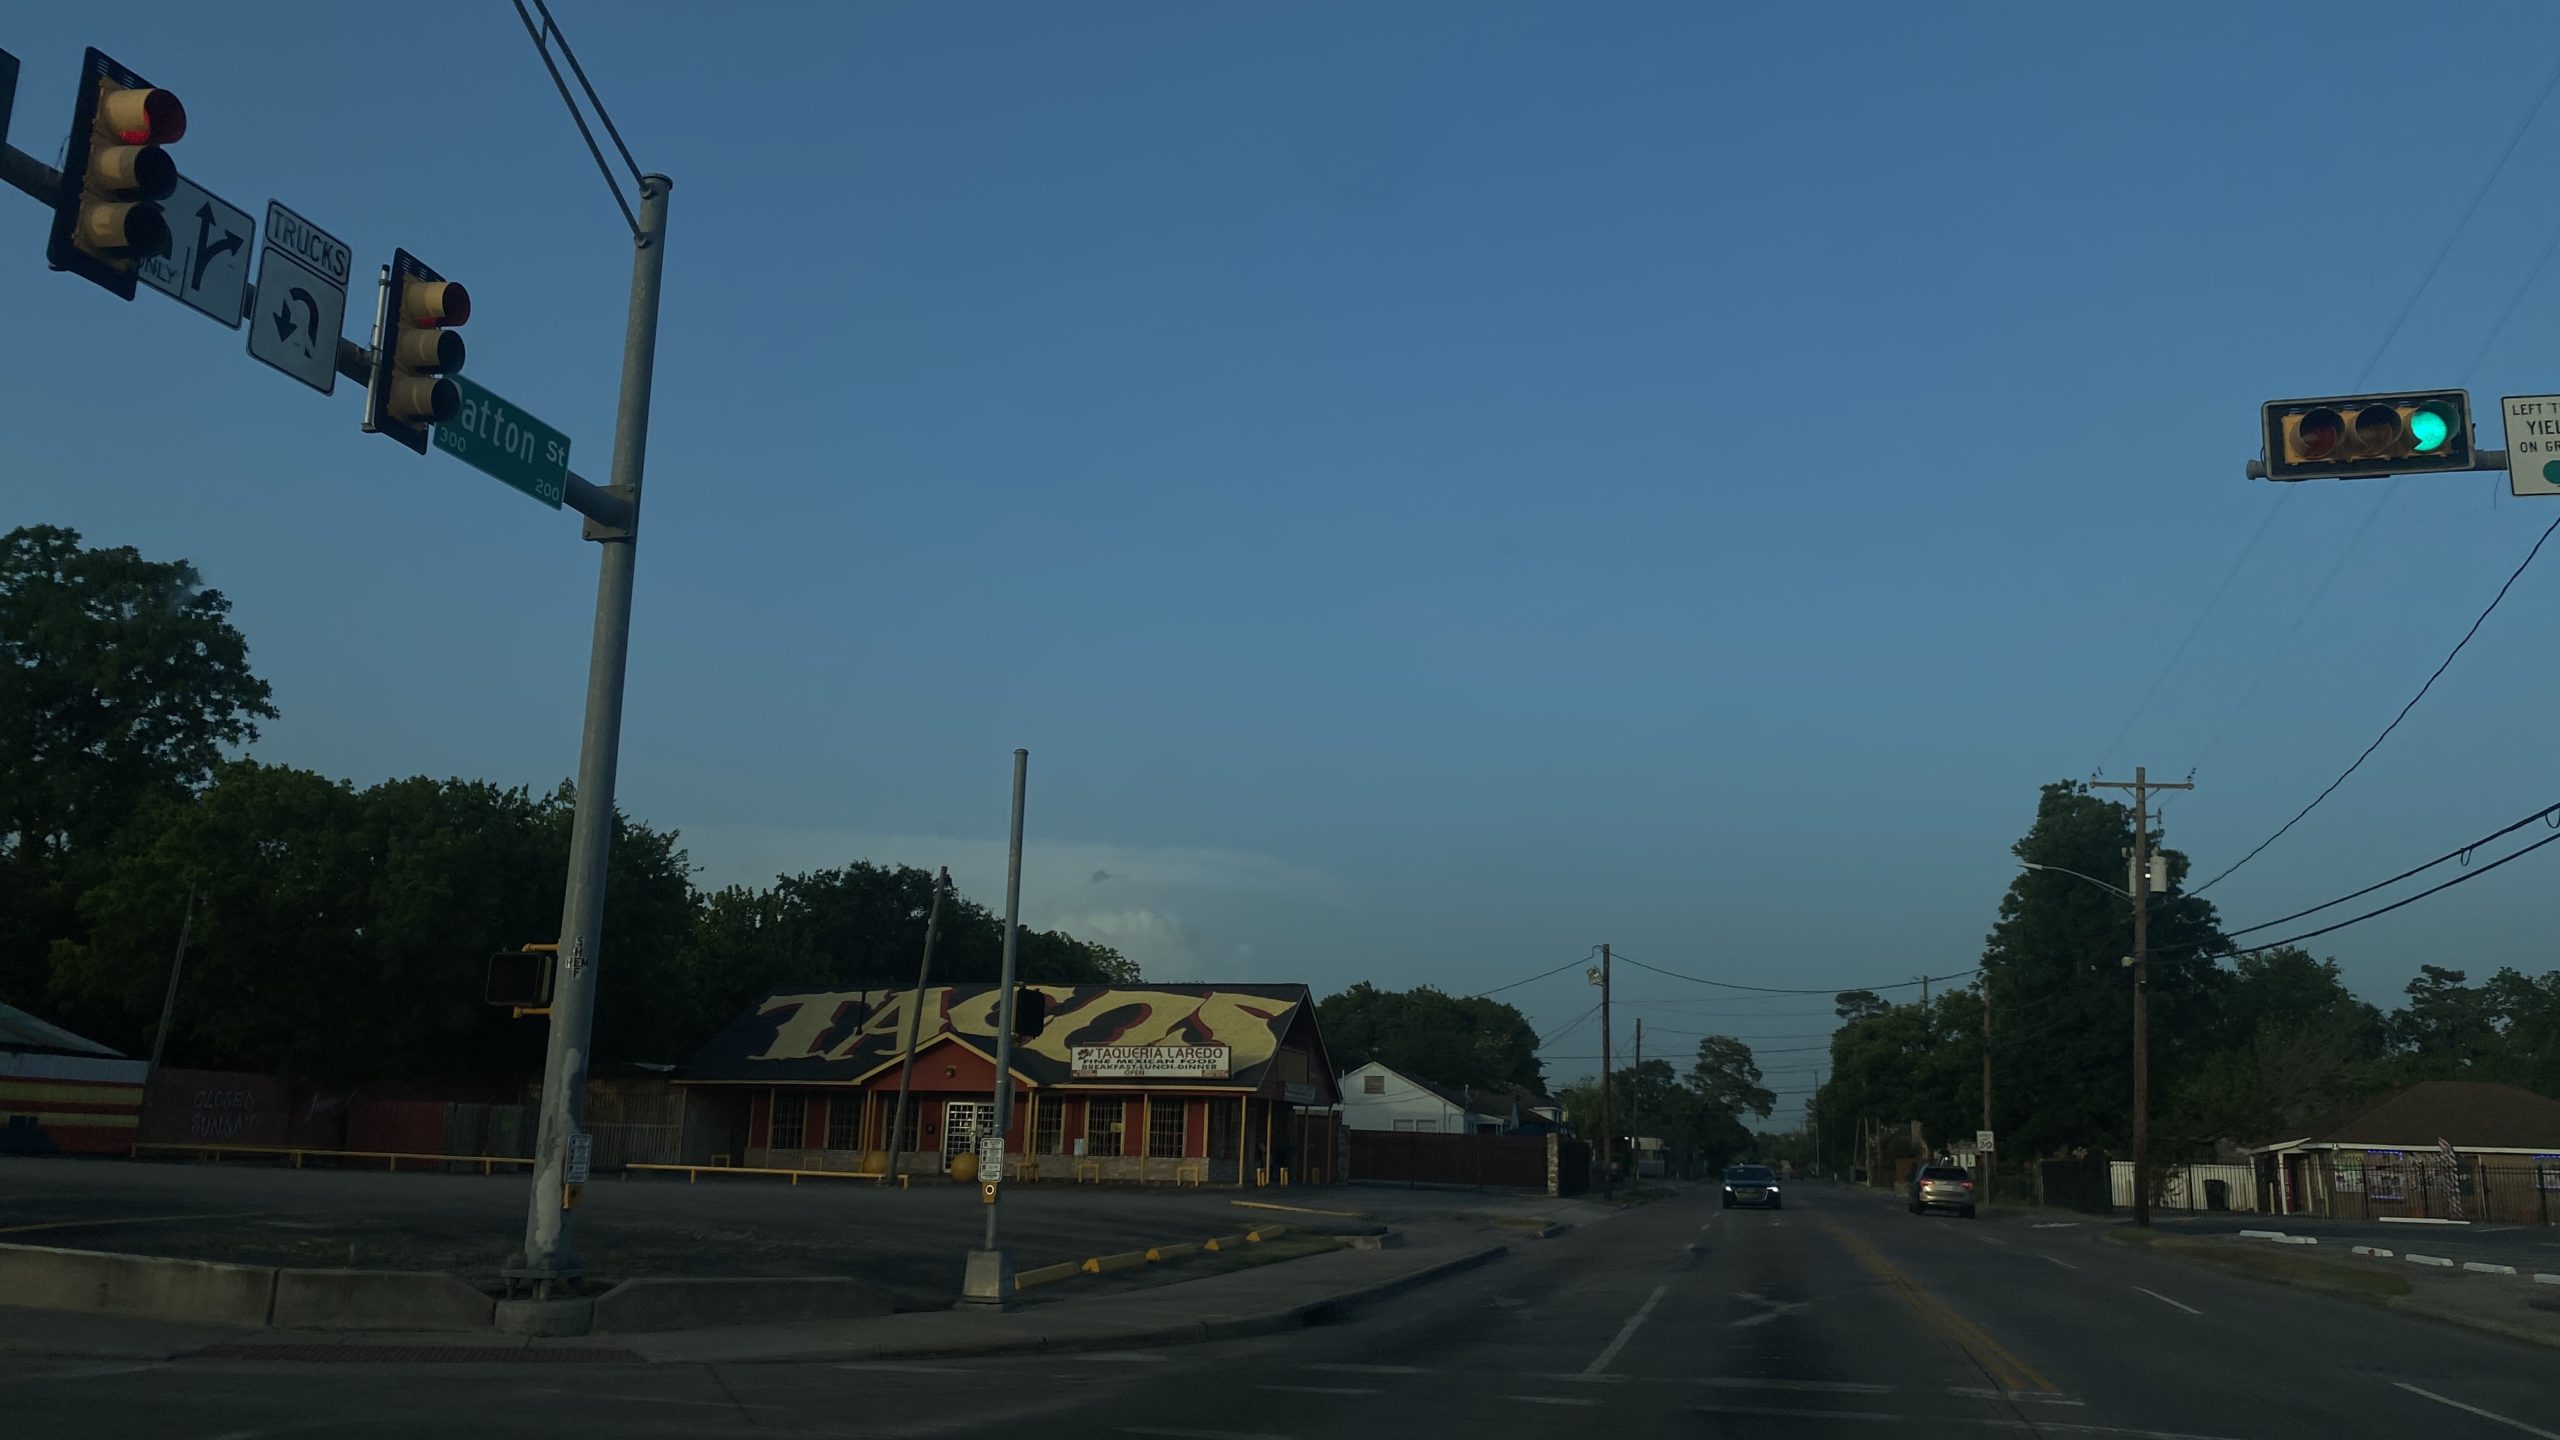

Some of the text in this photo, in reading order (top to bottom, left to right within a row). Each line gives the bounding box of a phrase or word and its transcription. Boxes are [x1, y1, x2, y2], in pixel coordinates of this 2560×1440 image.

[272, 209, 348, 278] TRUCKS
[2512, 403, 2542, 416] LEFT
[448, 377, 566, 467] atton St
[439, 426, 467, 453] 300
[2520, 441, 2538, 453] ON
[535, 478, 560, 501] 200
[746, 984, 1299, 1074] TACOS
[1096, 1047, 1223, 1059] TAQUERIA LAREDO
[193, 1090, 256, 1109] CLOSED
